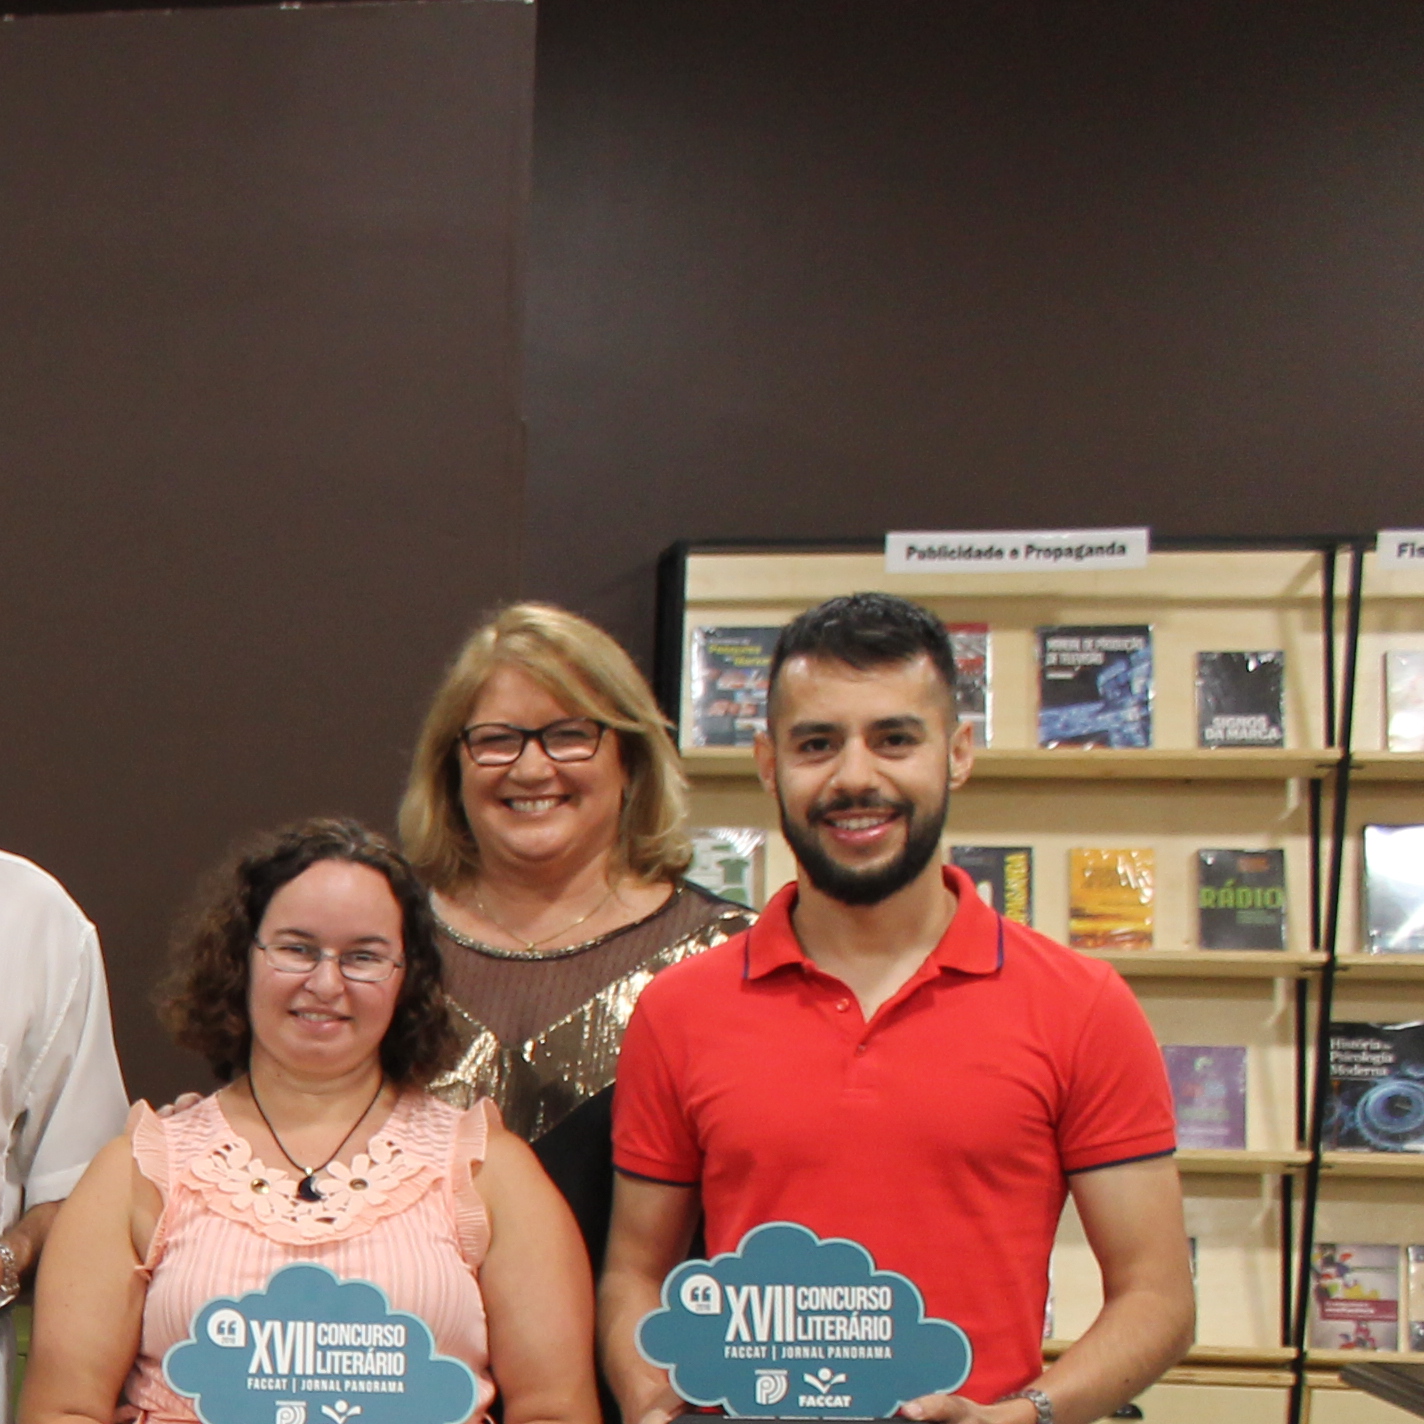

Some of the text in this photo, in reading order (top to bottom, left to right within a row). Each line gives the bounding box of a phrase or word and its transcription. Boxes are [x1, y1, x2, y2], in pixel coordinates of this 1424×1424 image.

[906, 541, 1127, 564] Publicidade e Propaganda
[1212, 715, 1269, 727] SIGNOS
[1204, 726, 1282, 739] DA MARCA
[1199, 878, 1284, 909] RÁDIO
[1330, 1037, 1380, 1050] História
[1330, 1051, 1396, 1065] Psicologia
[1330, 1065, 1390, 1076] Moderna
[797, 1286, 892, 1311] CONCURSO
[725, 1285, 796, 1342] XVII
[316, 1322, 406, 1347] CONCURSO
[797, 1312, 892, 1341] LITERÁRIO
[249, 1320, 315, 1375] XVII
[724, 1346, 892, 1360] FACCAT JORNAL PANORAMA
[316, 1348, 405, 1376] LITERÁRIO
[247, 1378, 404, 1393] FACCAT JORNAL PANORAMA
[799, 1395, 852, 1408] FACCAT
